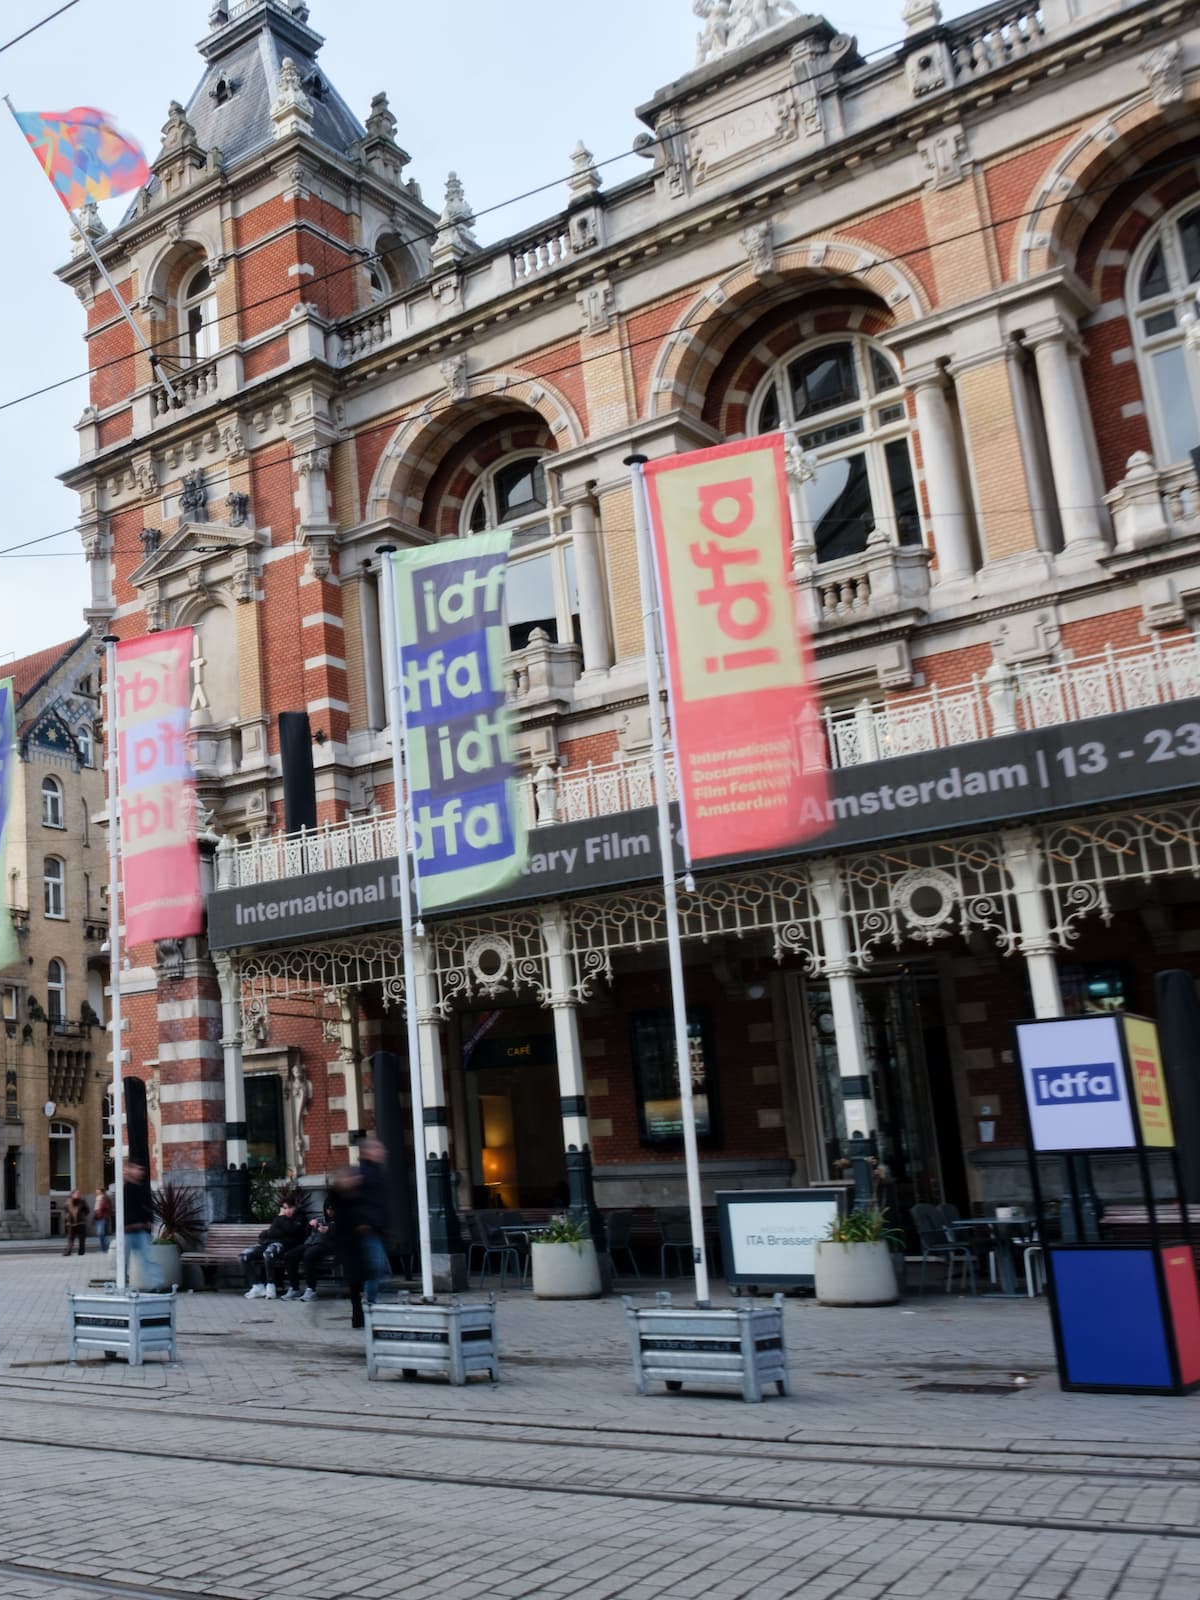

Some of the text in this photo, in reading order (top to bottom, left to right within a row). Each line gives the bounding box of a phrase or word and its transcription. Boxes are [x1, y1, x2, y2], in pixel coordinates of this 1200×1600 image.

[689, 476, 780, 675] idfa
[190, 634, 208, 710] ITA
[689, 739, 792, 766] International
[798, 763, 1030, 824] Amsterdam
[1056, 741, 1108, 778] 13
[1143, 722, 1200, 764] 23
[694, 776, 792, 800] Film Festival
[697, 795, 788, 818] Amsterdam
[235, 876, 385, 925] International
[585, 832, 650, 864] Film
[1037, 1071, 1113, 1099] idfa
[746, 1235, 764, 1246] ITA
